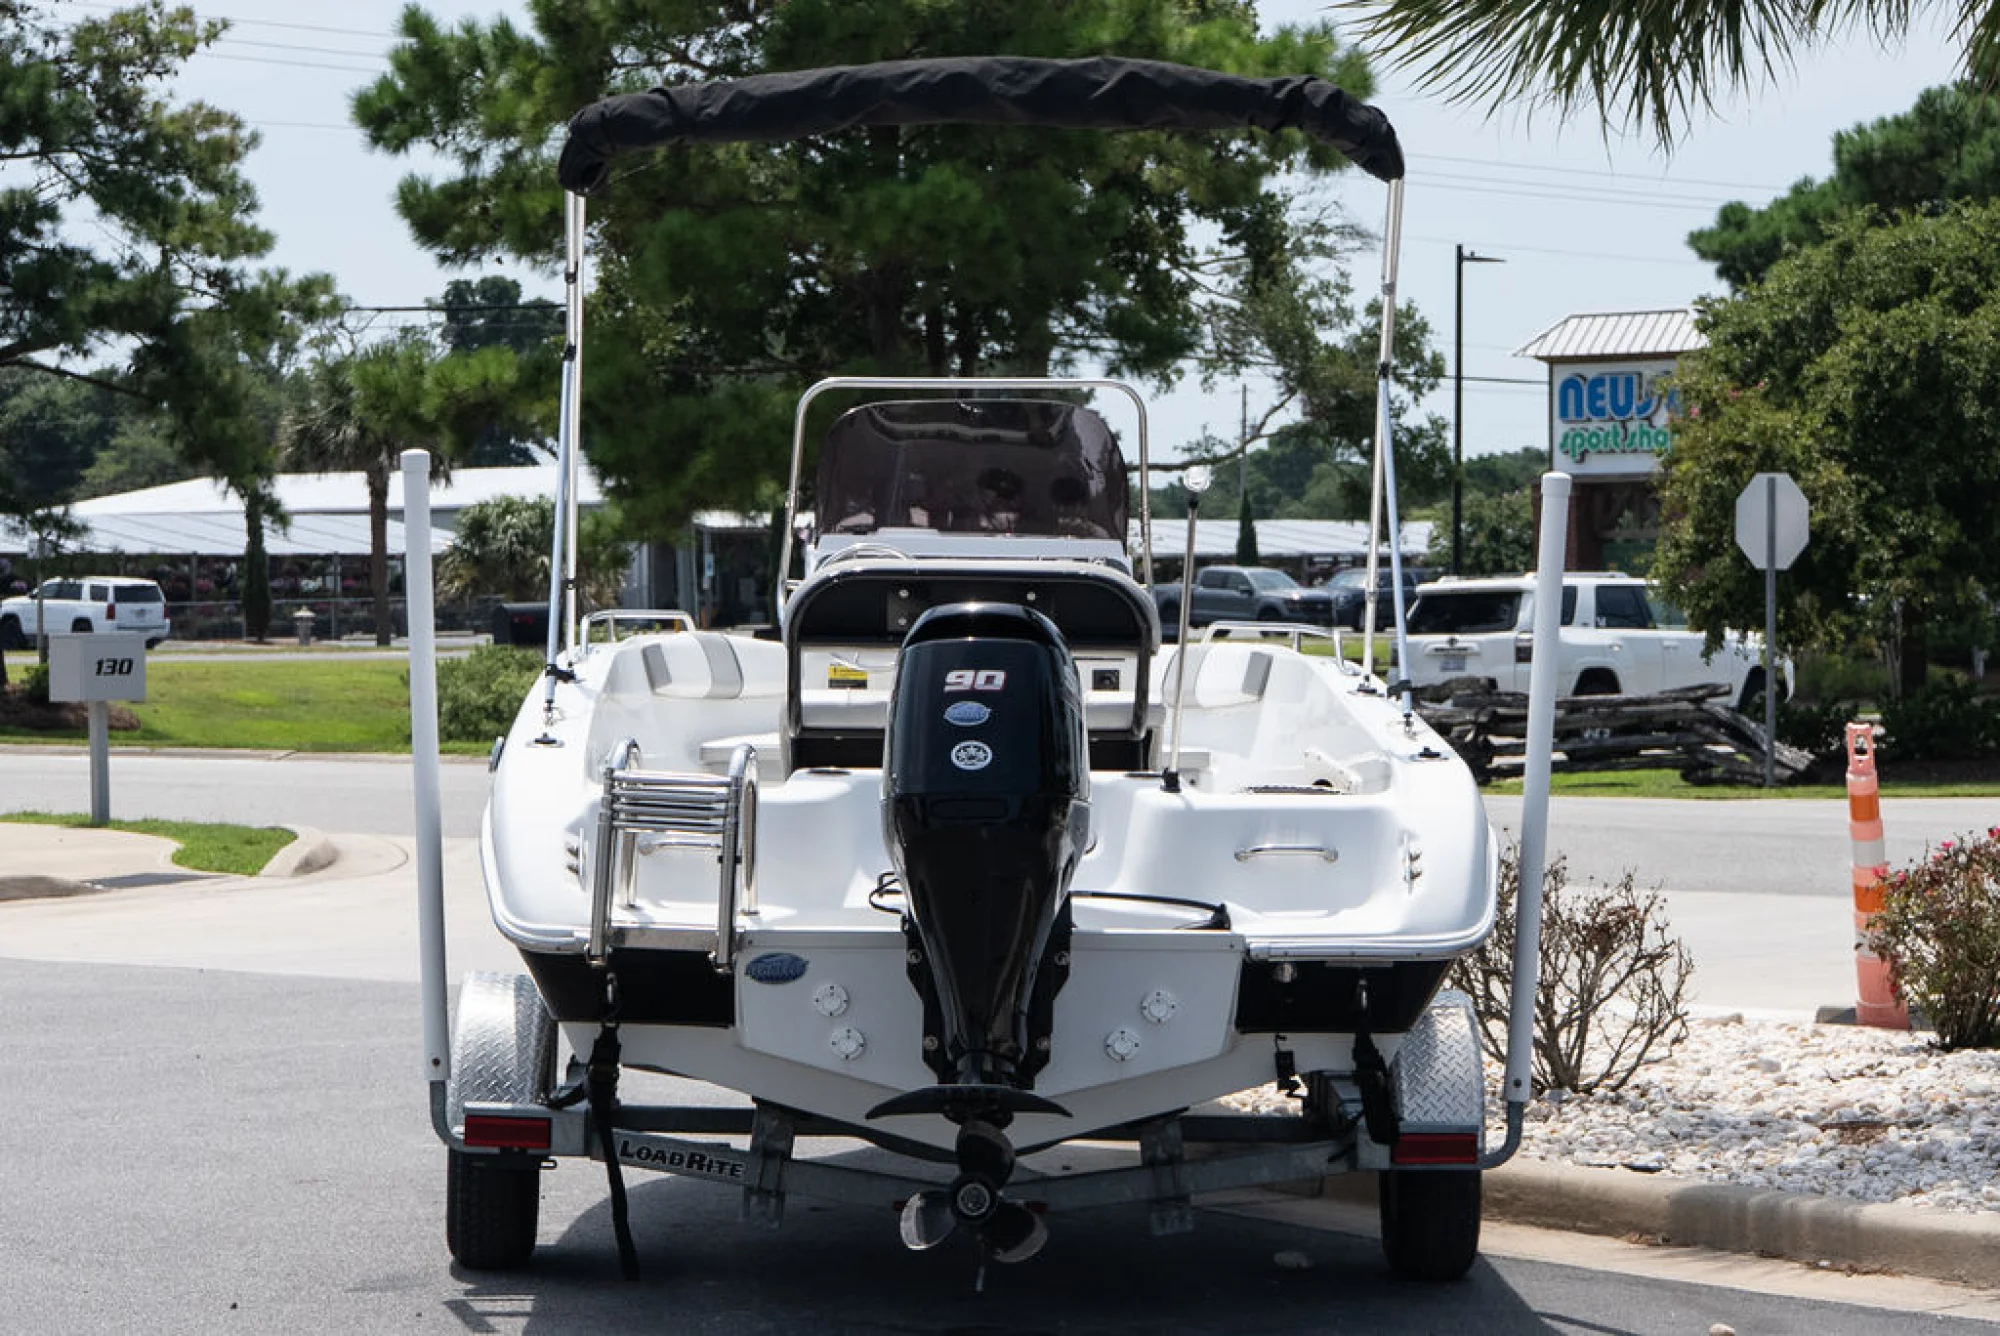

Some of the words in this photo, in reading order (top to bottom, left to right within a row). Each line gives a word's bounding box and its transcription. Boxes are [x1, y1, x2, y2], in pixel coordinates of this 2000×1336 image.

[1560, 423, 1620, 459] sport
[1626, 423, 1672, 454] sho
[95, 657, 134, 676] 130
[943, 669, 1006, 692] 90
